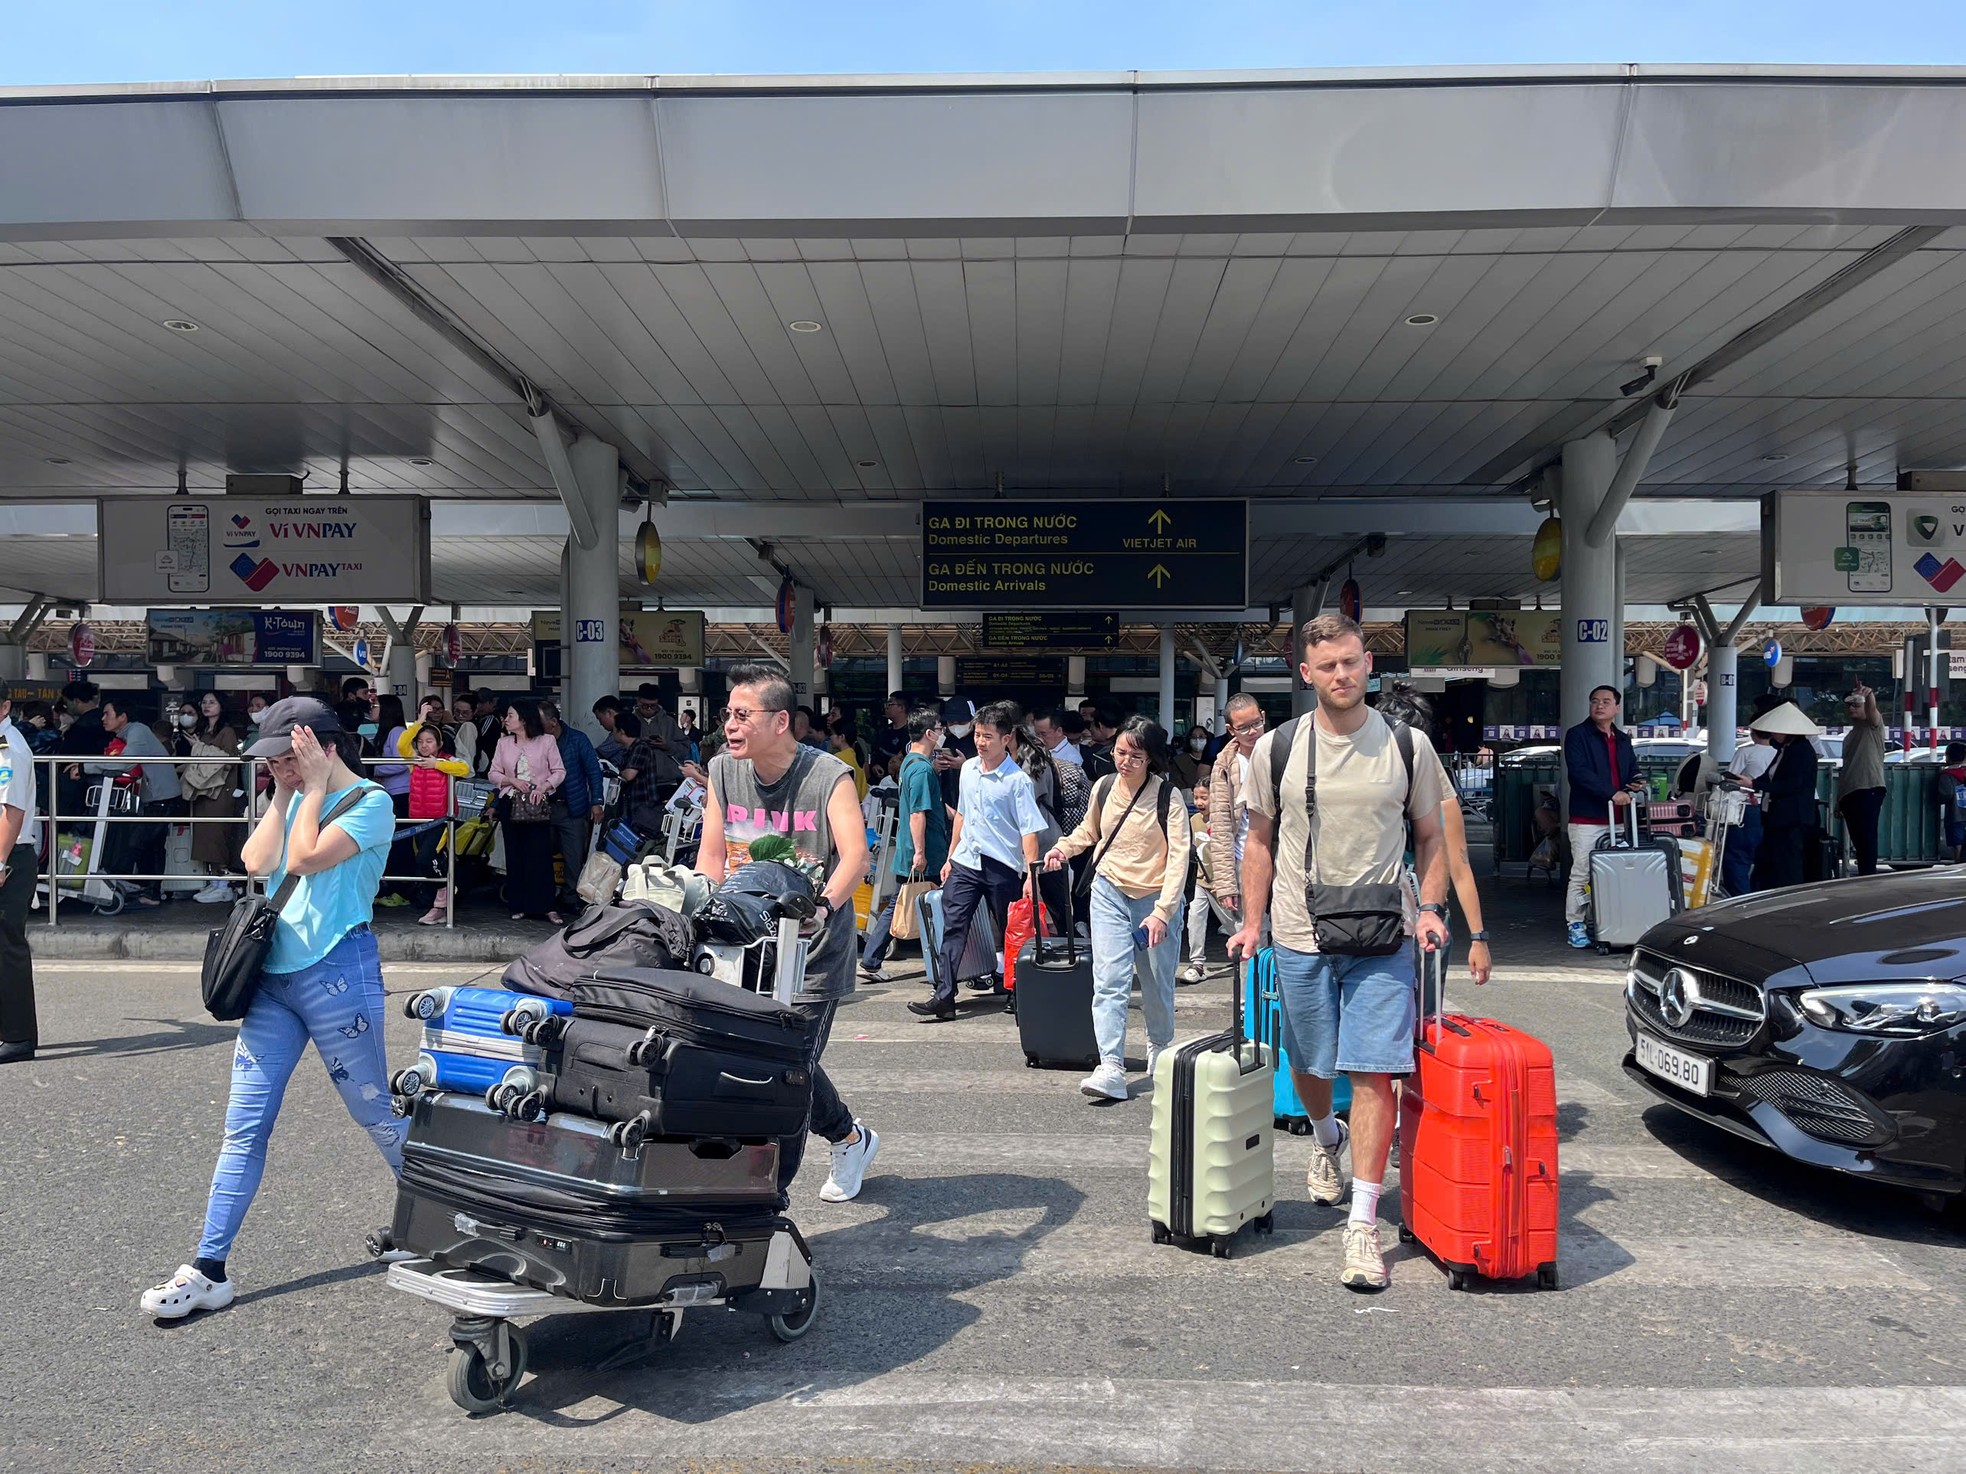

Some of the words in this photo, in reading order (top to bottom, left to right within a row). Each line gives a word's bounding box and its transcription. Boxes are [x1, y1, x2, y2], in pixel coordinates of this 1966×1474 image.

[265, 507, 281, 517] GỌI
[283, 507, 301, 515] TAXI
[303, 507, 326, 515] NGAY
[327, 505, 348, 515] TRÊN
[928, 517, 950, 529] GA
[955, 517, 970, 529] ĐI
[974, 517, 1028, 529] TRONG
[1033, 513, 1077, 529] NƯỚC
[293, 523, 357, 538] VNPAY
[928, 533, 991, 546] Domestic
[994, 533, 1068, 547] Departures
[1122, 538, 1172, 548] VIETJET
[1176, 538, 1197, 548] AIR
[282, 563, 341, 577] VNPAY
[928, 563, 950, 575] GA
[954, 558, 987, 575] ĐẾN
[992, 563, 1046, 575] TRONG
[1050, 559, 1094, 575] NƯỚC
[928, 580, 991, 592] Domestic
[994, 580, 1046, 592] Arrivals
[576, 621, 603, 641] C-03
[1578, 621, 1608, 641] C-02
[726, 803, 818, 832] PINK
